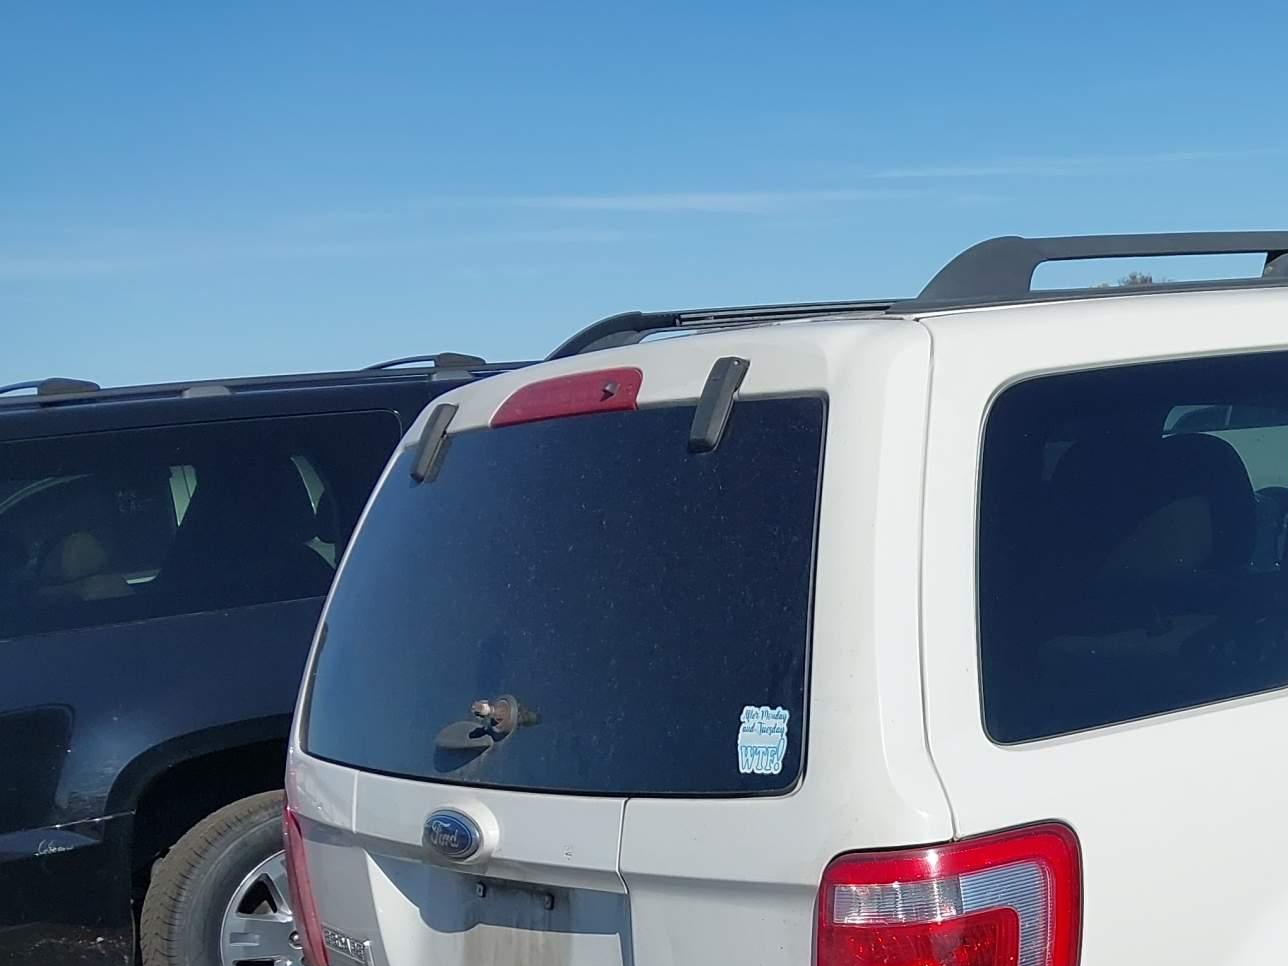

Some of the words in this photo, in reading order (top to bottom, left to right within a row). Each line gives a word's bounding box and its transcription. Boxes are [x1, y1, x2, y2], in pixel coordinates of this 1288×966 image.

[761, 709, 788, 723] Monday
[742, 723, 756, 733] and
[758, 722, 785, 738] Tuesday
[740, 738, 785, 771] WTF!
[431, 820, 459, 848] Ford
